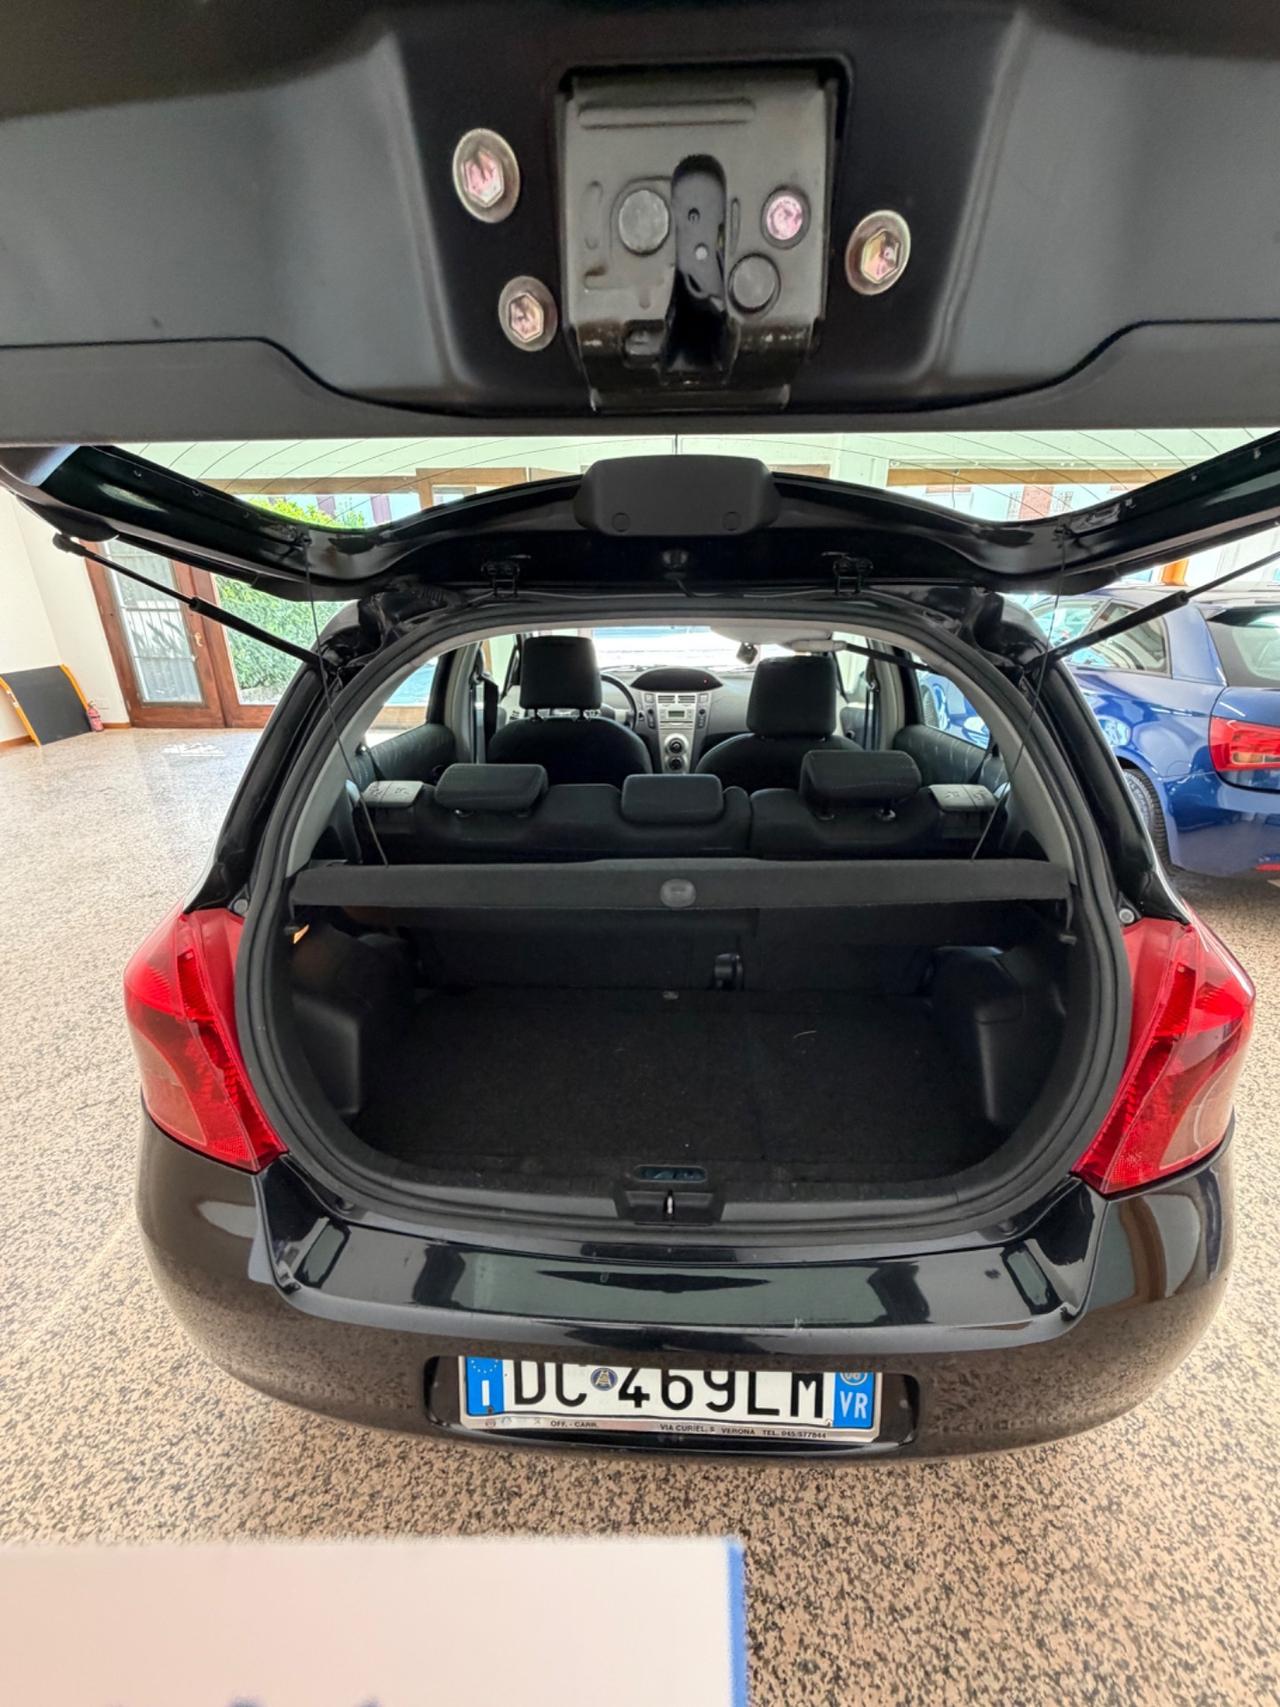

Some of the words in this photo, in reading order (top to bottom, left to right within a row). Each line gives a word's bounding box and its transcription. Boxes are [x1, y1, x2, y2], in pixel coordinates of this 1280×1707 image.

[839, 1391, 868, 1418] VR
[659, 1423, 674, 1431] VIA
[721, 1427, 756, 1435] VERONA
